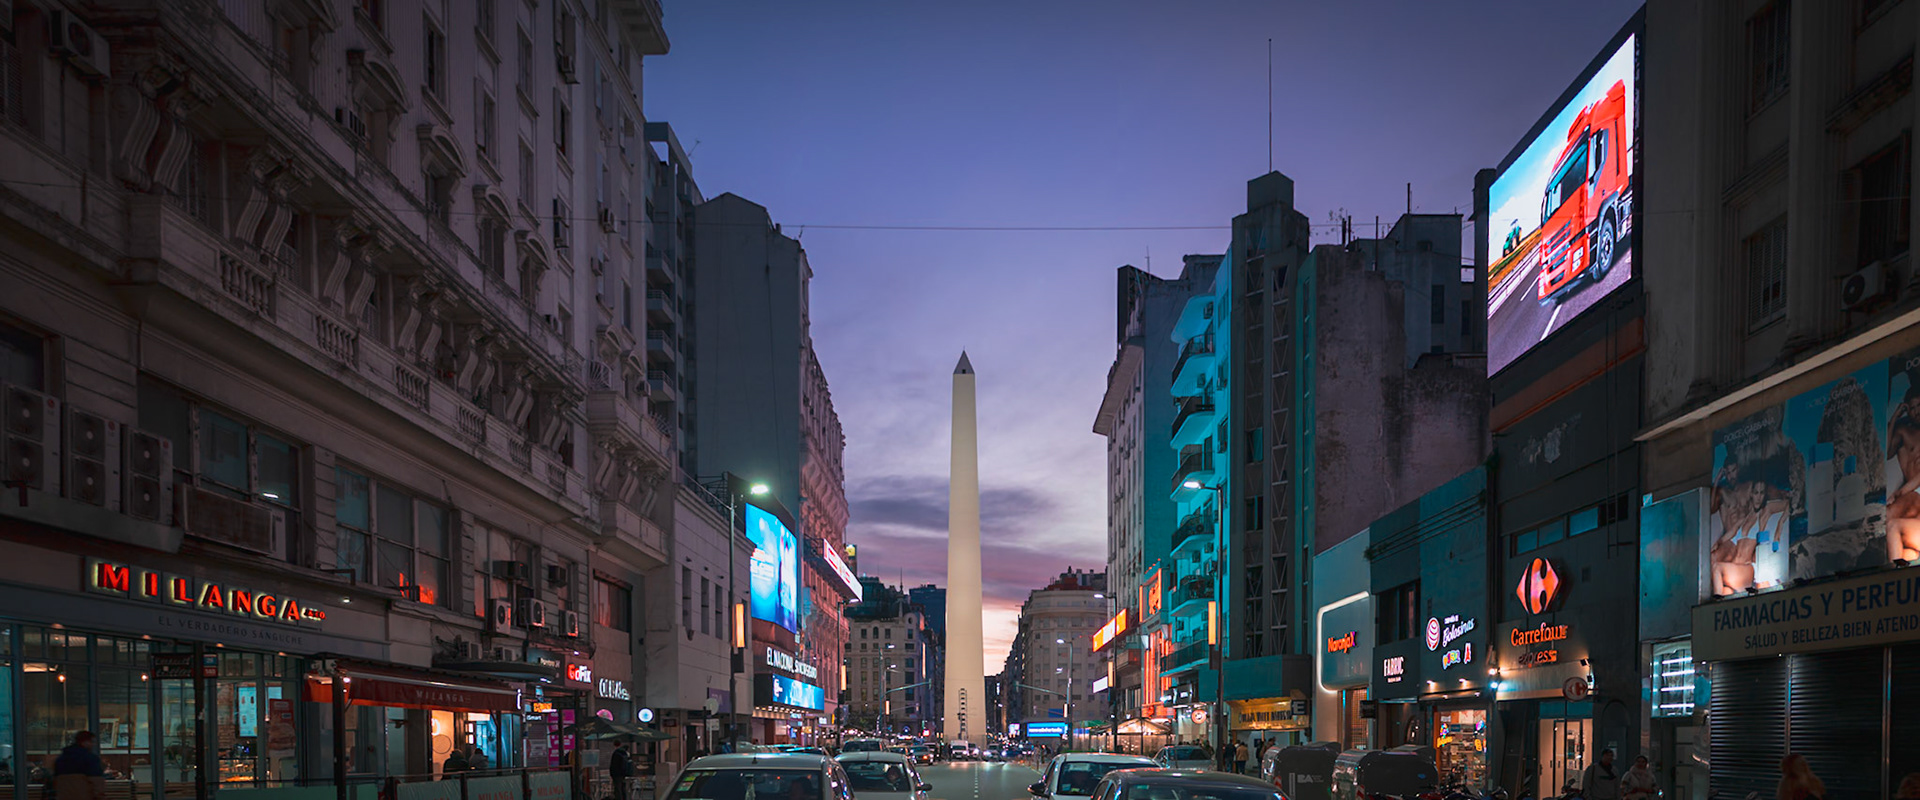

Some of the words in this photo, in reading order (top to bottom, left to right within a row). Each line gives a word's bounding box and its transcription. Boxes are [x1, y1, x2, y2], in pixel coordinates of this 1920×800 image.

[97, 562, 300, 620] MILANGA
[1713, 595, 1812, 631] FARMACIAS
[1820, 591, 1833, 616] Y
[158, 616, 173, 627] EL
[178, 619, 249, 638] VERDADERO
[252, 629, 303, 646] SANGUCHE
[1510, 622, 1568, 647] Carrefour
[1744, 632, 1777, 650] SALUD
[1780, 631, 1788, 646] Y
[1791, 625, 1839, 645] BELLEZA
[1842, 621, 1871, 639] BIEN
[1876, 614, 1919, 634] ATEND
[1383, 656, 1405, 677] FABRIC
[1518, 650, 1558, 668] express
[567, 663, 592, 684] GoFix
[416, 689, 464, 703] MILANGA
[537, 785, 565, 797] MILANGA
